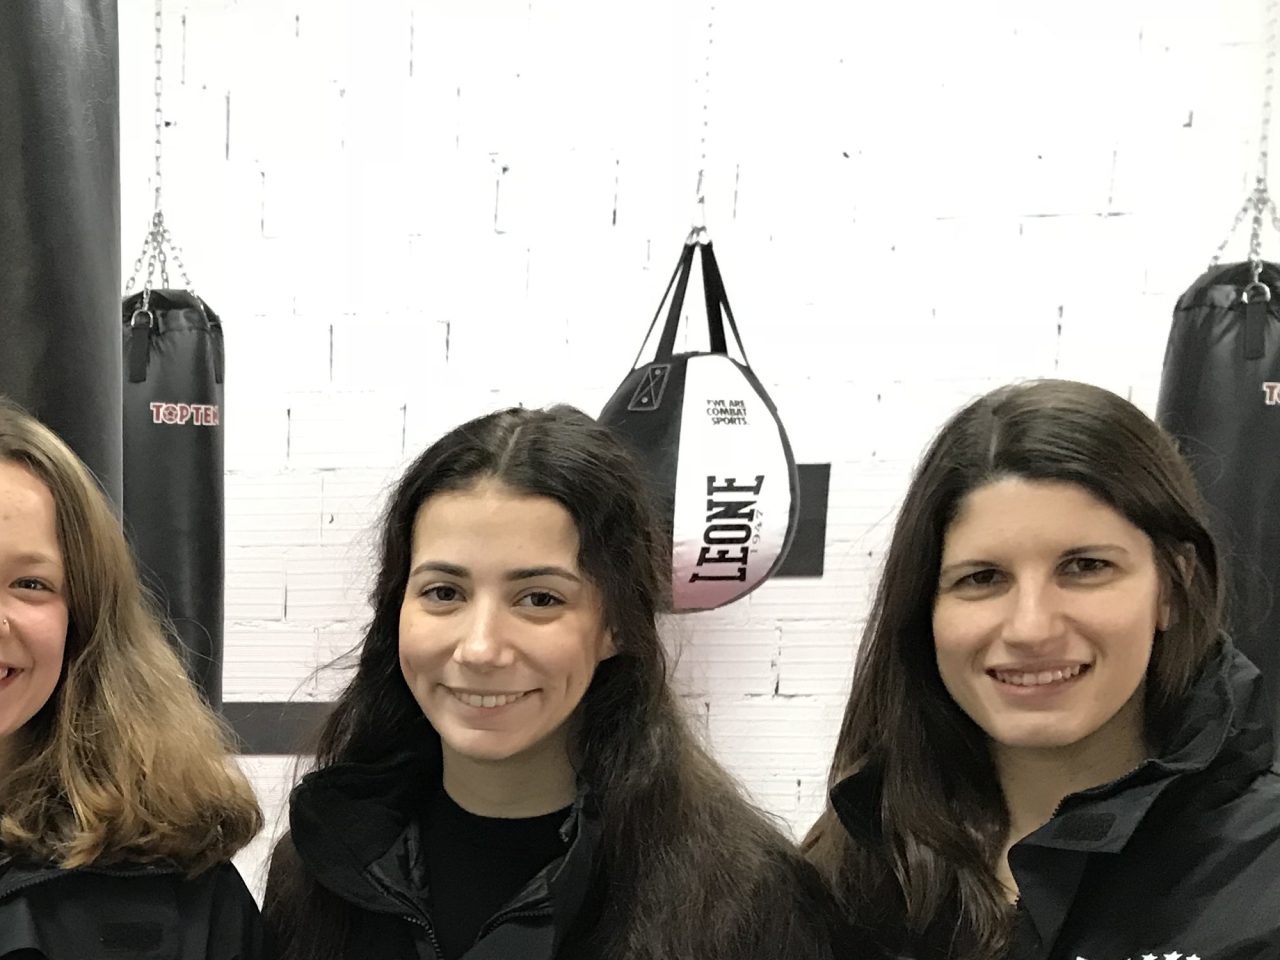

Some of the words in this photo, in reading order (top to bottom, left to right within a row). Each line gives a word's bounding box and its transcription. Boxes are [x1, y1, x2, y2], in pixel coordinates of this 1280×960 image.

[729, 399, 745, 408] ARE
[706, 408, 747, 416] COMBAT
[688, 475, 765, 583] LEONE
